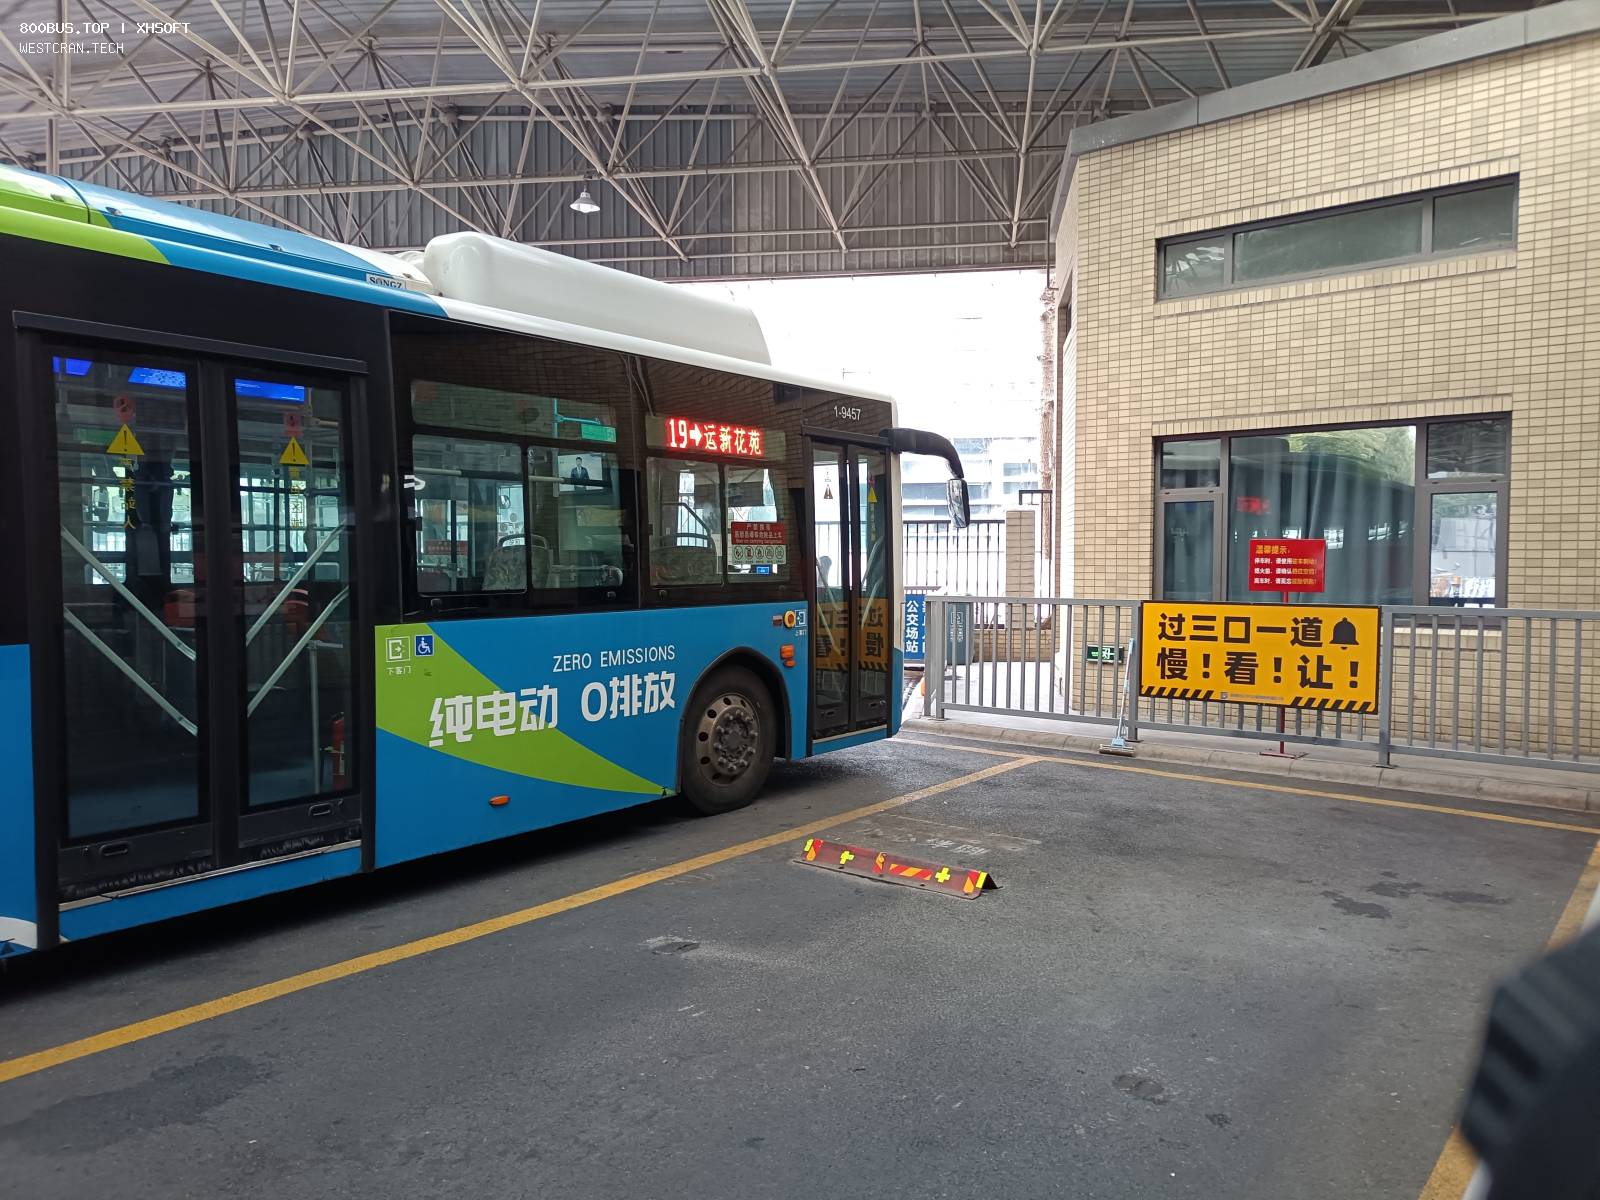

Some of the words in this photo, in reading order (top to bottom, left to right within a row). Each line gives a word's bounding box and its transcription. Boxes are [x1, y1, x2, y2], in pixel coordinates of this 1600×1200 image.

[369, 276, 402, 289] SONGZ
[833, 405, 862, 421] 1-9457
[668, 418, 689, 448] 19
[703, 424, 762, 455] 运新花苑
[905, 600, 919, 653] 公交场站
[1157, 612, 1325, 648] 过三口一道
[552, 653, 592, 673] ZERO
[600, 645, 676, 668] EMISSIONS
[428, 684, 558, 748] 纯电动
[580, 670, 676, 722] 0排放
